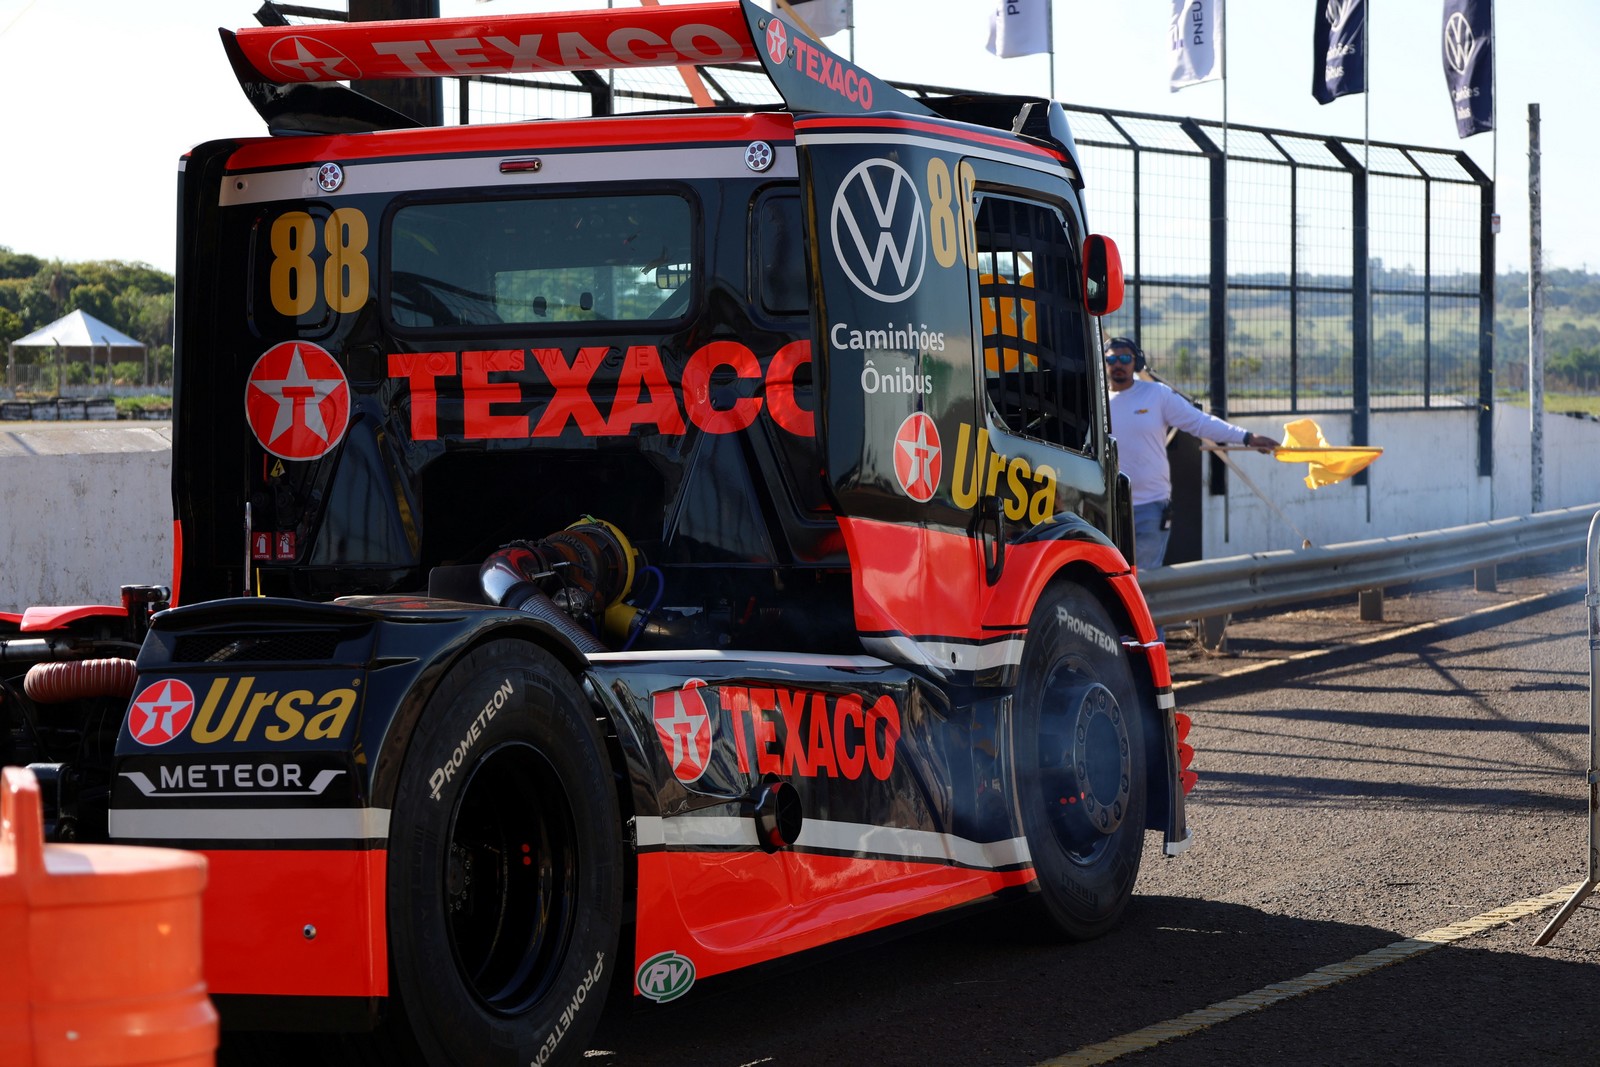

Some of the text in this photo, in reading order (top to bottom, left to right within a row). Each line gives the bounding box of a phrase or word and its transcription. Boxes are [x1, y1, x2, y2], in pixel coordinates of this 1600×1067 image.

[372, 23, 744, 76] TEXACO
[793, 36, 873, 110] TEXACO
[926, 157, 978, 270] 88
[269, 207, 370, 317] 88
[831, 323, 945, 352] Caminhões
[861, 359, 933, 394] Ônibus
[951, 422, 1057, 525] Ursa
[1056, 605, 1119, 657] PROMETEON
[190, 676, 358, 744] Ursa
[428, 678, 515, 801] PROMETEON
[719, 685, 901, 781] TEXACO
[160, 763, 303, 788] METEOR
